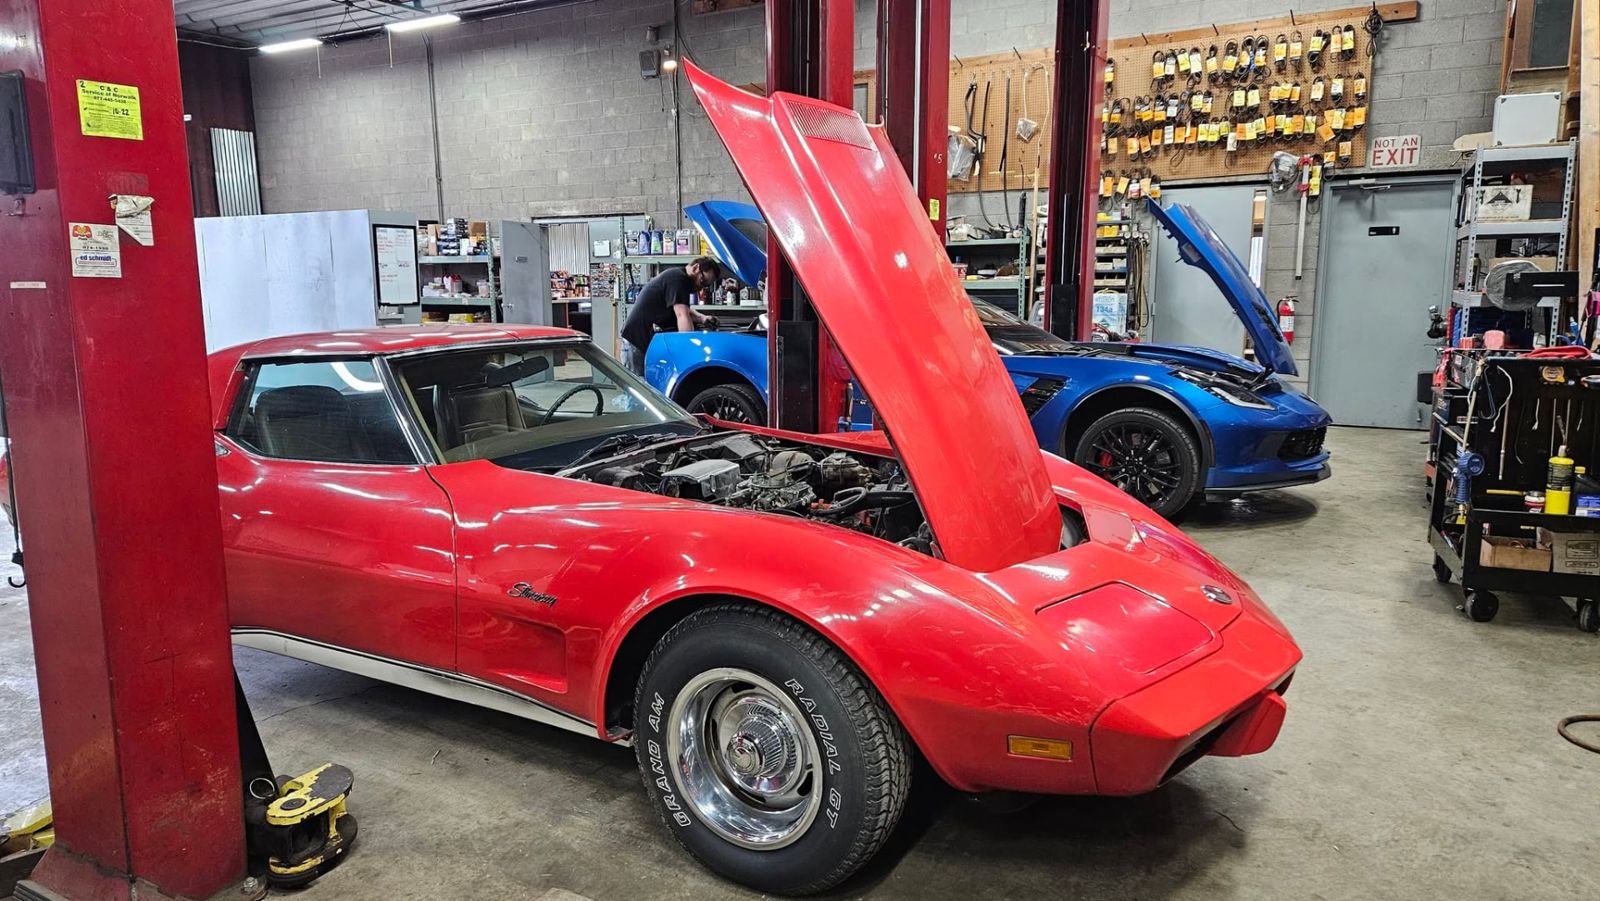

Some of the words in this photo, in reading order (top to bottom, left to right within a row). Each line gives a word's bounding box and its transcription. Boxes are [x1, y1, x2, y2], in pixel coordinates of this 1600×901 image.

[80, 80, 86, 88] 2
[82, 88, 104, 96] Service
[112, 92, 137, 100] Norwalk
[1374, 138, 1396, 149] NOT
[1402, 137, 1418, 147] AN
[1371, 147, 1419, 167] EXIT
[649, 692, 666, 733] AM
[784, 678, 841, 775] RADIAL
[828, 787, 842, 829] GT
[648, 740, 692, 828] GRAND
